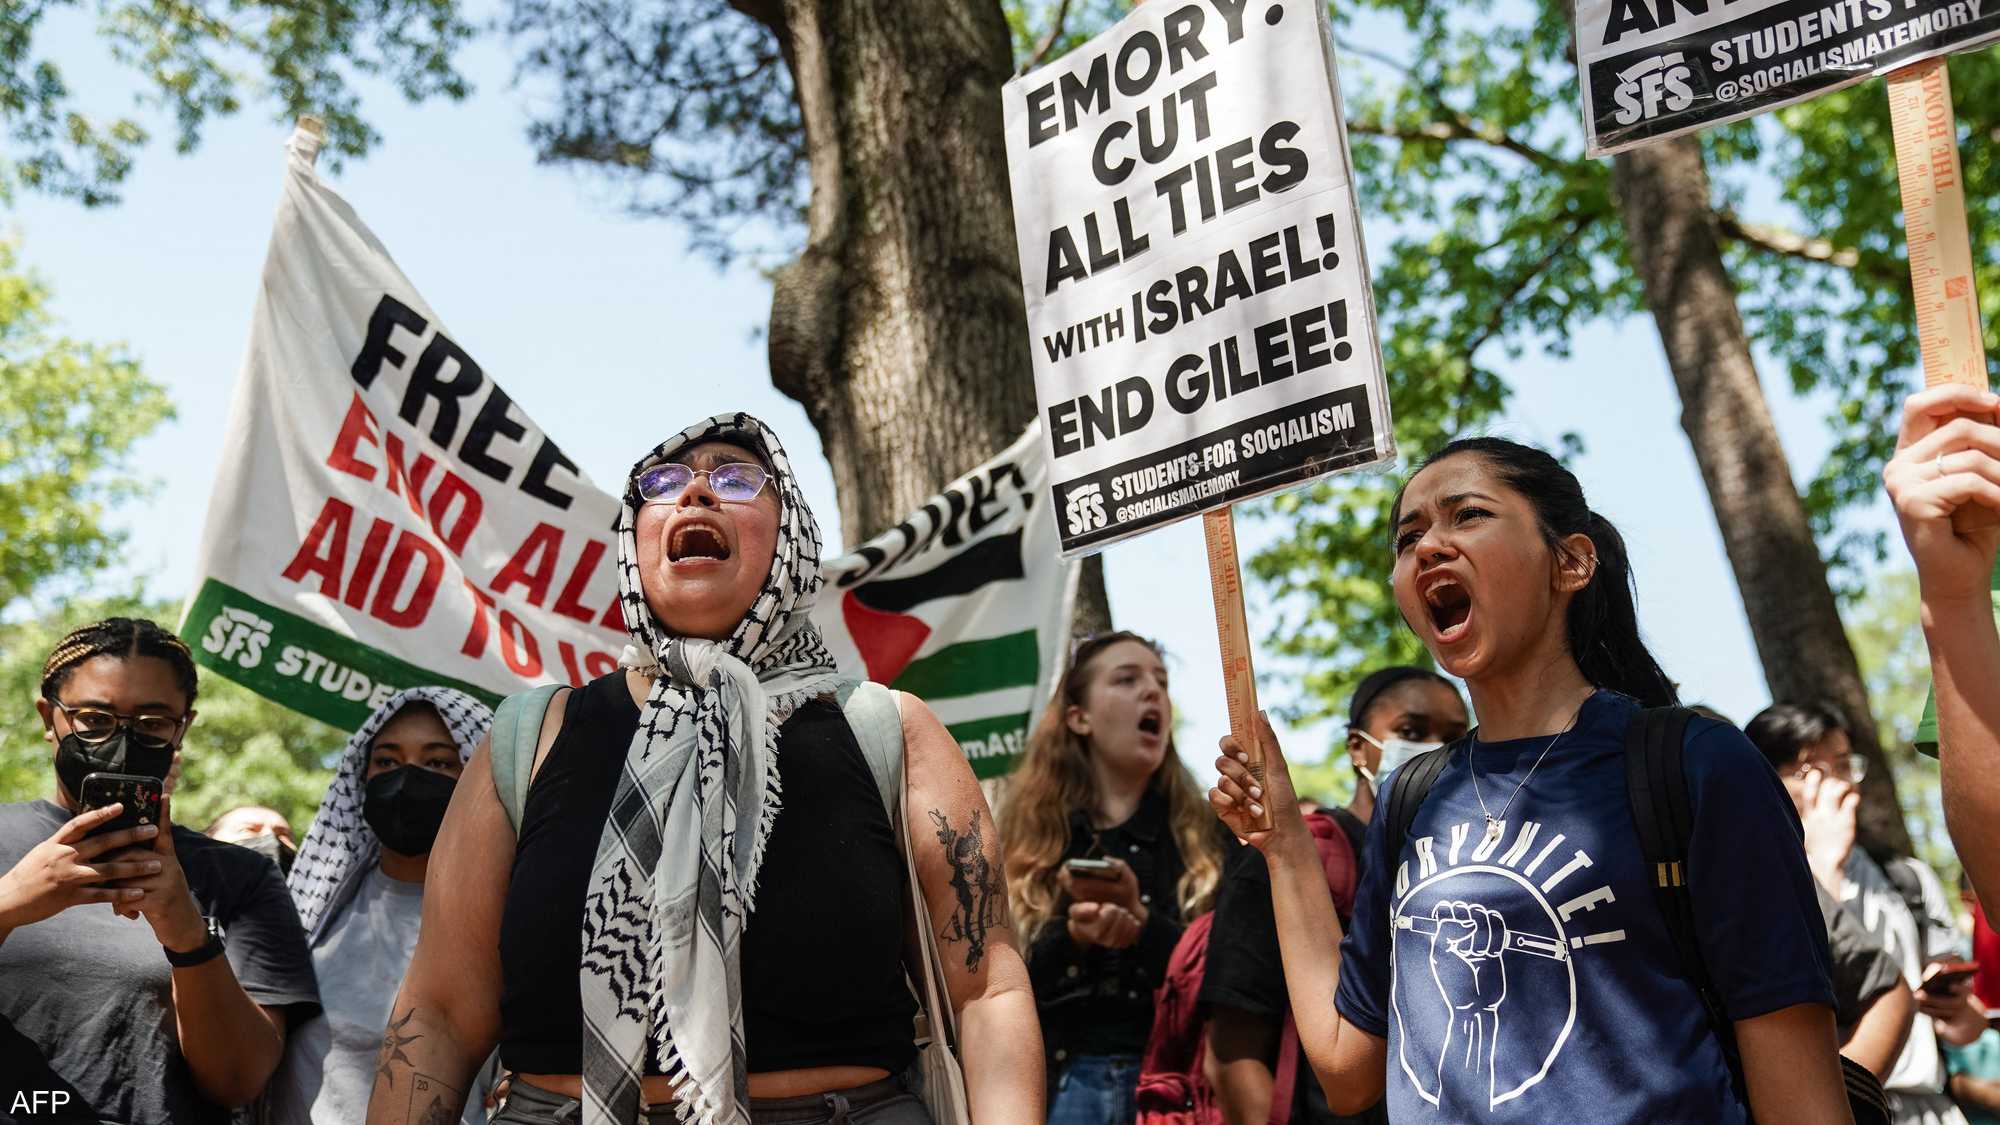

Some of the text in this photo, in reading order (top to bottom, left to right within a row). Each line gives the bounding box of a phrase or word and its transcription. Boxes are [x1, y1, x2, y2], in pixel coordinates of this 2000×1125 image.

[1711, 0, 1892, 72] STUDENTS
[1715, 0, 1982, 102] @SOCIALISMATEMORY
[1092, 71, 1218, 186] CUT
[1614, 63, 1694, 125] SFS
[1045, 121, 1309, 297] ALL TIES
[1931, 143, 1954, 194] THE
[1042, 213, 1341, 364] WITH ISRAEL!
[350, 293, 580, 511] FREE
[1047, 298, 1354, 459] END GILEE!
[326, 390, 484, 559] END
[1111, 402, 1356, 500] STUDENTS FOR SOCIALISM
[1065, 491, 1108, 536] SFS
[1116, 470, 1241, 523] @SOCIALISMATEMORY
[282, 497, 445, 630] AID
[461, 574, 544, 679] TO
[1223, 562, 1237, 595] THE
[202, 614, 271, 669] SFS
[275, 645, 403, 709] STUDE
[416, 1079, 429, 1092] 20
